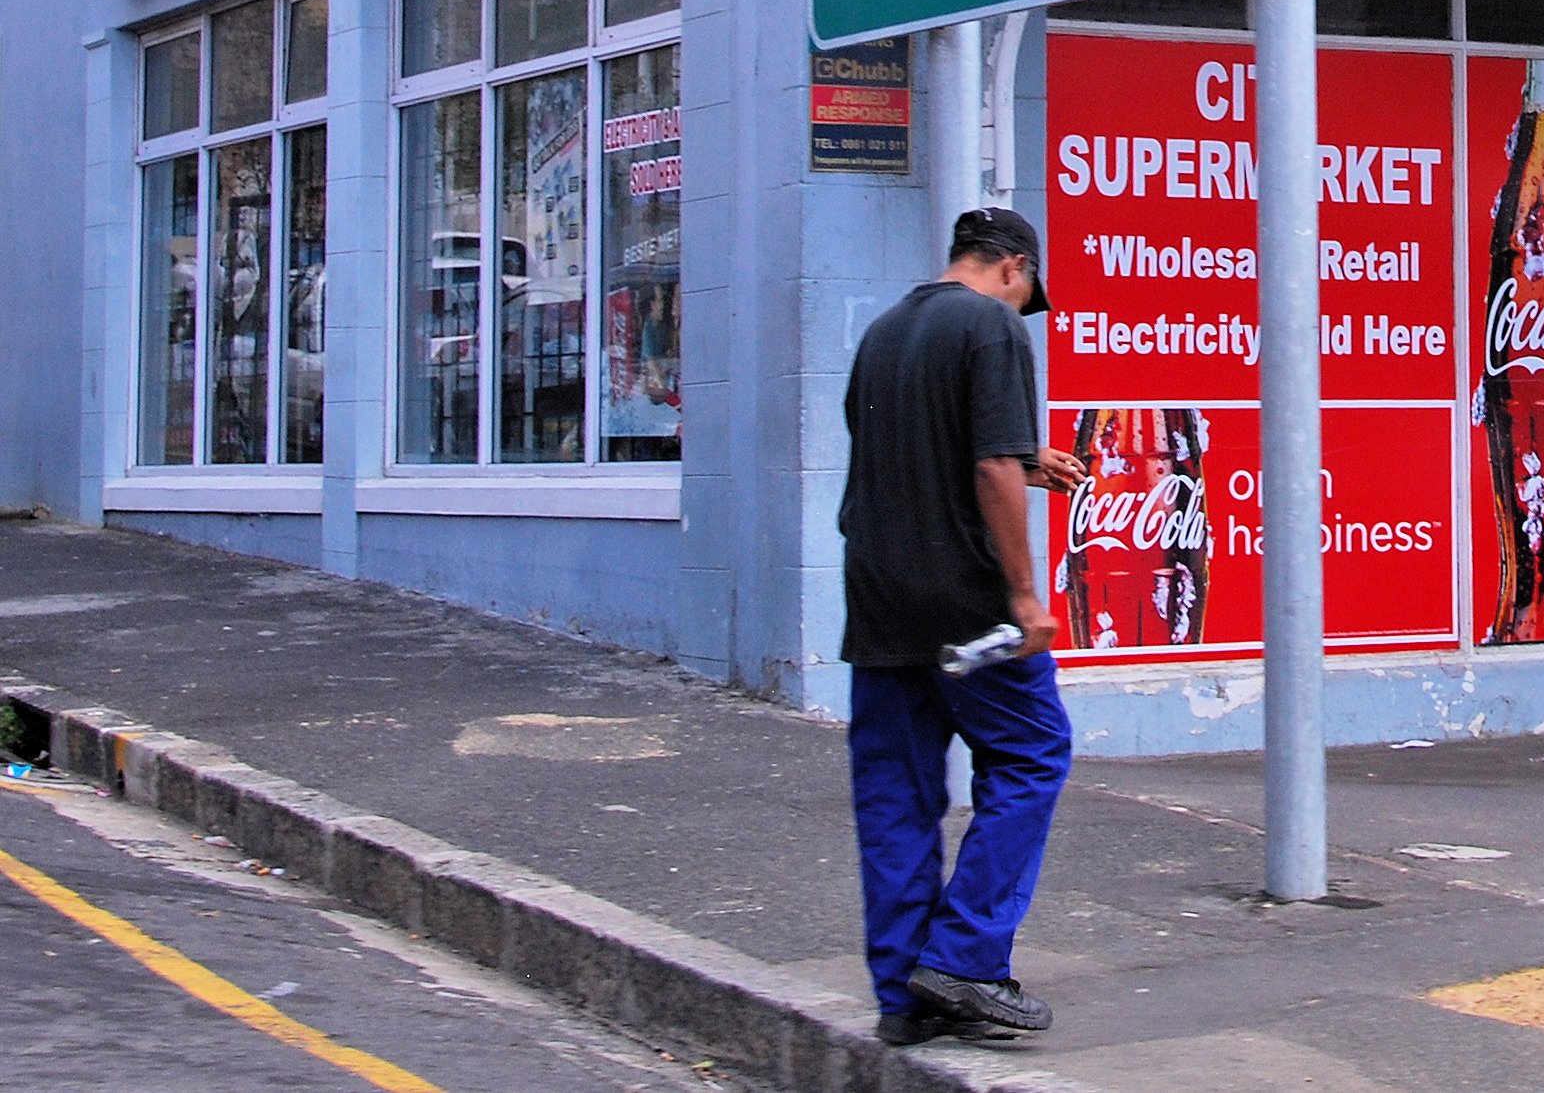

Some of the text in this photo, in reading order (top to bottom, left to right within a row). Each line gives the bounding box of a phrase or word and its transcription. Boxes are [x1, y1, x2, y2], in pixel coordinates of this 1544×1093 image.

[815, 105, 905, 121] RESPONSE
[831, 90, 891, 106] ARMED
[1057, 135, 1442, 206] SUPERMRKET
[1320, 240, 1420, 281] Retail
[1364, 314, 1446, 356] Here
[1068, 474, 1206, 555] Coca-Cola
